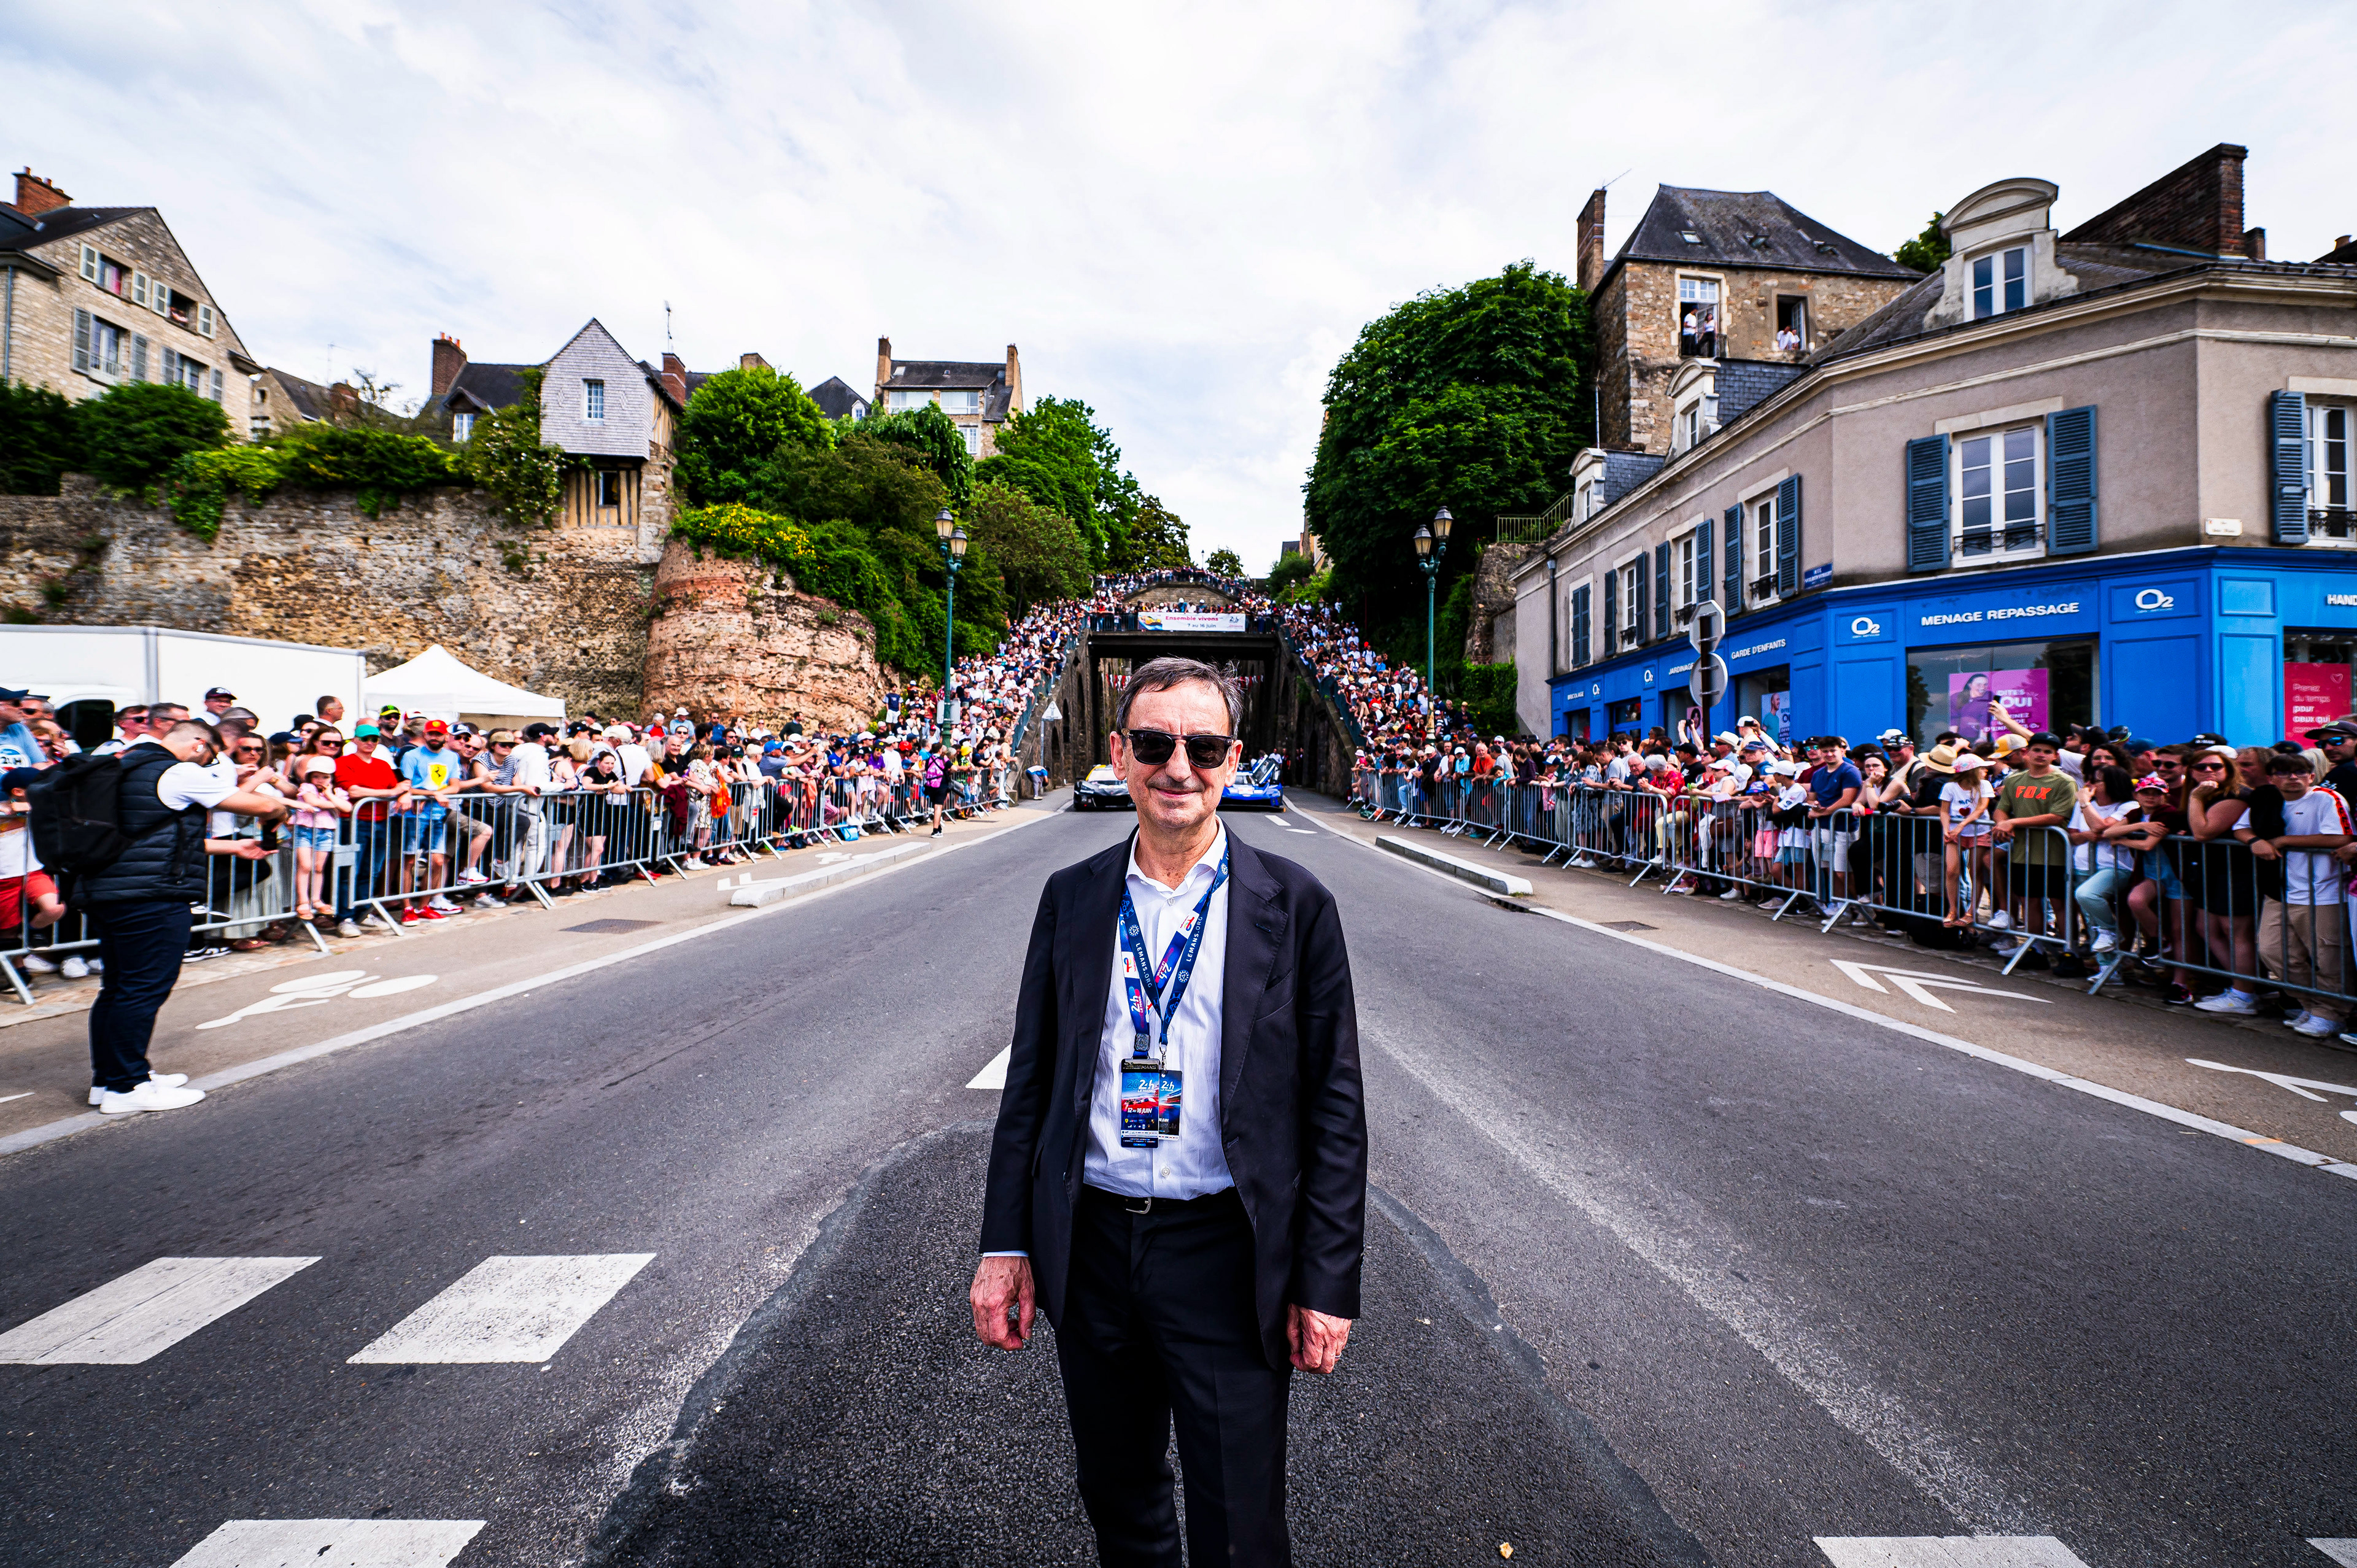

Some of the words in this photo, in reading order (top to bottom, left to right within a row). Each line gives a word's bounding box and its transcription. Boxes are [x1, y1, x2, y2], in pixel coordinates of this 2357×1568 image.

[1921, 612, 1983, 626] MENAGE
[1986, 602, 2080, 620] REPASSAGE
[1731, 647, 1751, 660] GARDE
[1752, 638, 1786, 654] D'ENFANTS
[2000, 696, 2032, 708] OUI
[2305, 695, 2331, 704] temps
[2315, 714, 2331, 724] qui
[2015, 786, 2053, 800] FOX
[1186, 916, 1203, 962] LEMANS.ORG
[1136, 943, 1153, 988] LEMANS.ORG
